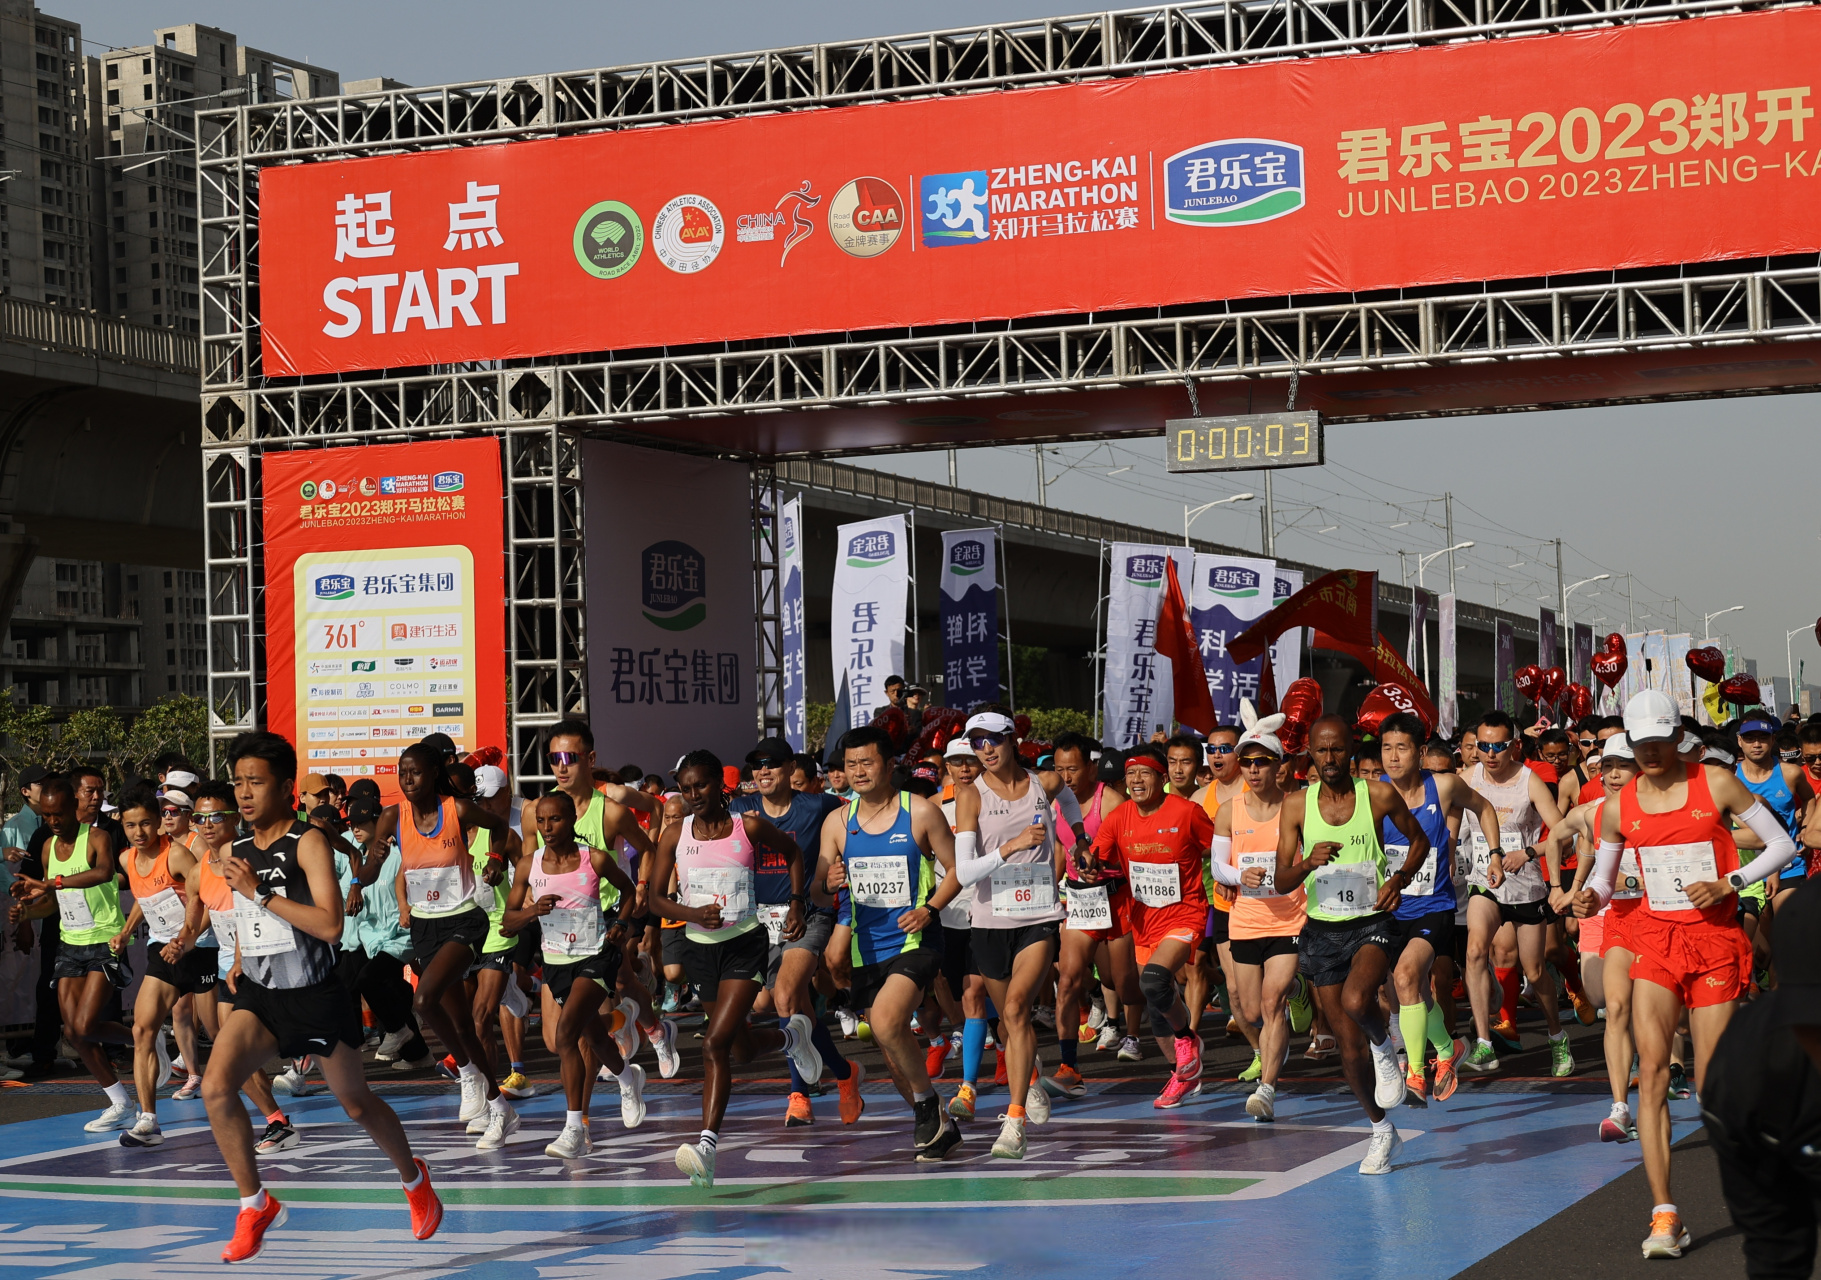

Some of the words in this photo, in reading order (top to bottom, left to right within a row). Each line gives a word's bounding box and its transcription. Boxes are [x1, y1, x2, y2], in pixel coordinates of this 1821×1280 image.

[1336, 86, 1814, 184] 君乐宝2023郑开
[990, 155, 1136, 189] ZHENG-KAI
[1184, 151, 1287, 193] 君乐宝
[991, 181, 1138, 214] MARATHON
[1183, 195, 1238, 208] JUNLEBAO
[1337, 175, 1530, 218] JUNLEBAO
[655, 212, 668, 240] CHINESE
[667, 197, 696, 213] ATHLETICS
[697, 199, 723, 234] ASSOCIATION
[736, 211, 785, 228] CHINA
[857, 207, 899, 225] CAA
[992, 206, 1139, 241] 郑开马拉松赛
[844, 233, 891, 249] 金牌赛事
[616, 262, 631, 273] RACE
[630, 243, 641, 262] LABEL
[658, 242, 720, 272] 中国田径协会
[322, 262, 520, 338] START
[1177, 422, 1309, 462] 0:00:03
[437, 474, 460, 484] 君乐宝
[299, 495, 465, 520] 君乐宝2023郑开马拉松赛
[299, 518, 345, 529] JUNLEBAO
[649, 552, 699, 592] 君乐宝
[1214, 569, 1255, 586] 君乐宝
[319, 577, 351, 590] 君乐宝
[362, 572, 454, 595] 君乐宝集团
[649, 593, 678, 604] JUNLEBAO
[323, 620, 365, 650] 361°
[409, 623, 457, 638] 建行生活
[1700, 650, 1723, 662] 3:30
[1595, 662, 1618, 673] 4:30
[609, 647, 740, 706] 君乐宝集团
[389, 682, 419, 690] COLMO
[857, 881, 904, 895] A10237
[1134, 883, 1176, 897] A11886
[1674, 877, 1683, 893] 3
[426, 890, 440, 901] 69
[712, 894, 728, 906] 71
[1015, 889, 1032, 902] 66
[1337, 890, 1354, 903] 18
[63, 911, 75, 921] 15
[1071, 907, 1107, 918] A10209
[158, 916, 166, 926] 9
[254, 922, 261, 938] 5
[562, 932, 577, 943] 70
